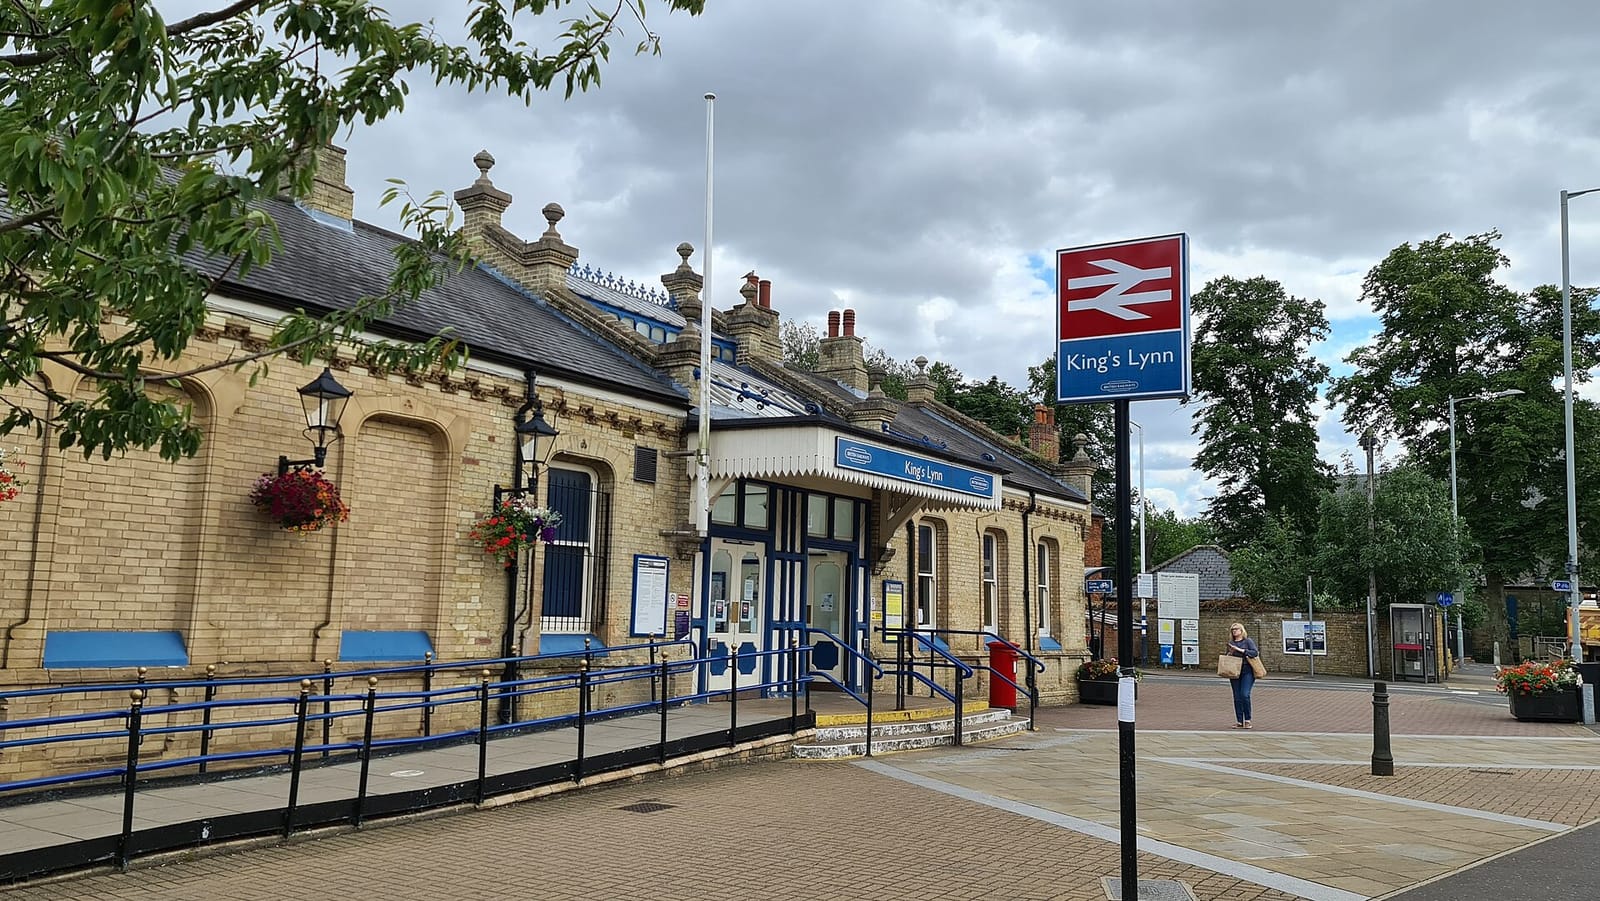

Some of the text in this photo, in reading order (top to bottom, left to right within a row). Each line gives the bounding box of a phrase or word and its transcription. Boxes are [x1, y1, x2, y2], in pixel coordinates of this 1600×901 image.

[1067, 349, 1174, 373] King's Lynn
[905, 460, 943, 483] King's Lynn
